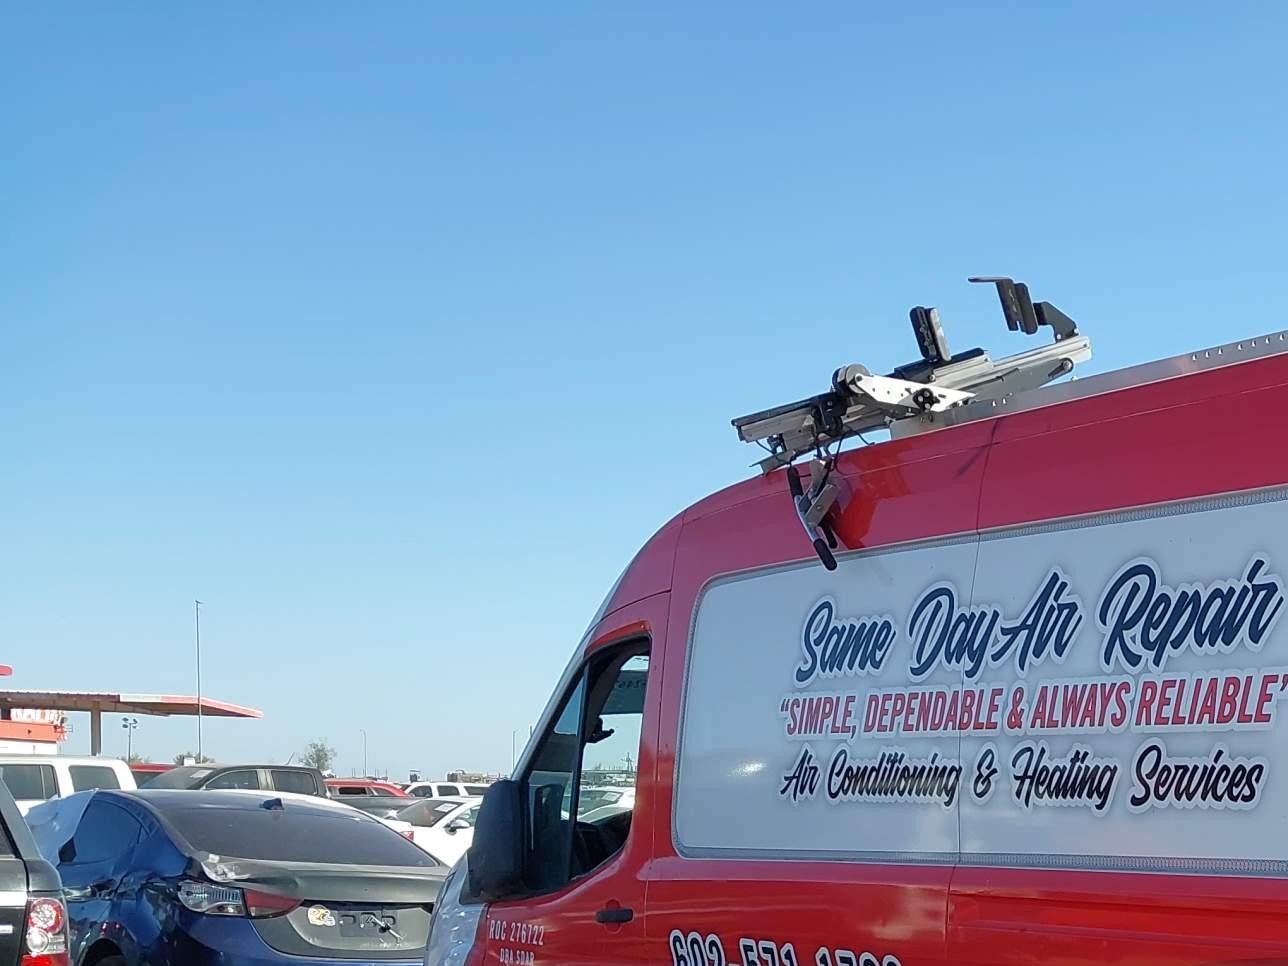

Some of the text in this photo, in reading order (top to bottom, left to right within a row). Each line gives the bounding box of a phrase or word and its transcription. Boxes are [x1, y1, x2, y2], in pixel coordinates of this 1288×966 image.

[796, 558, 1284, 683] Same Day Air Repair
[865, 686, 1002, 734] DEPENDABLE
[1006, 685, 1025, 730] &
[1031, 681, 1130, 729] ALWAYS
[780, 743, 1265, 811] Air Conditioning & Heating Services
[488, 918, 545, 946] ROC 276722
[499, 947, 535, 966] DBA SDAR
